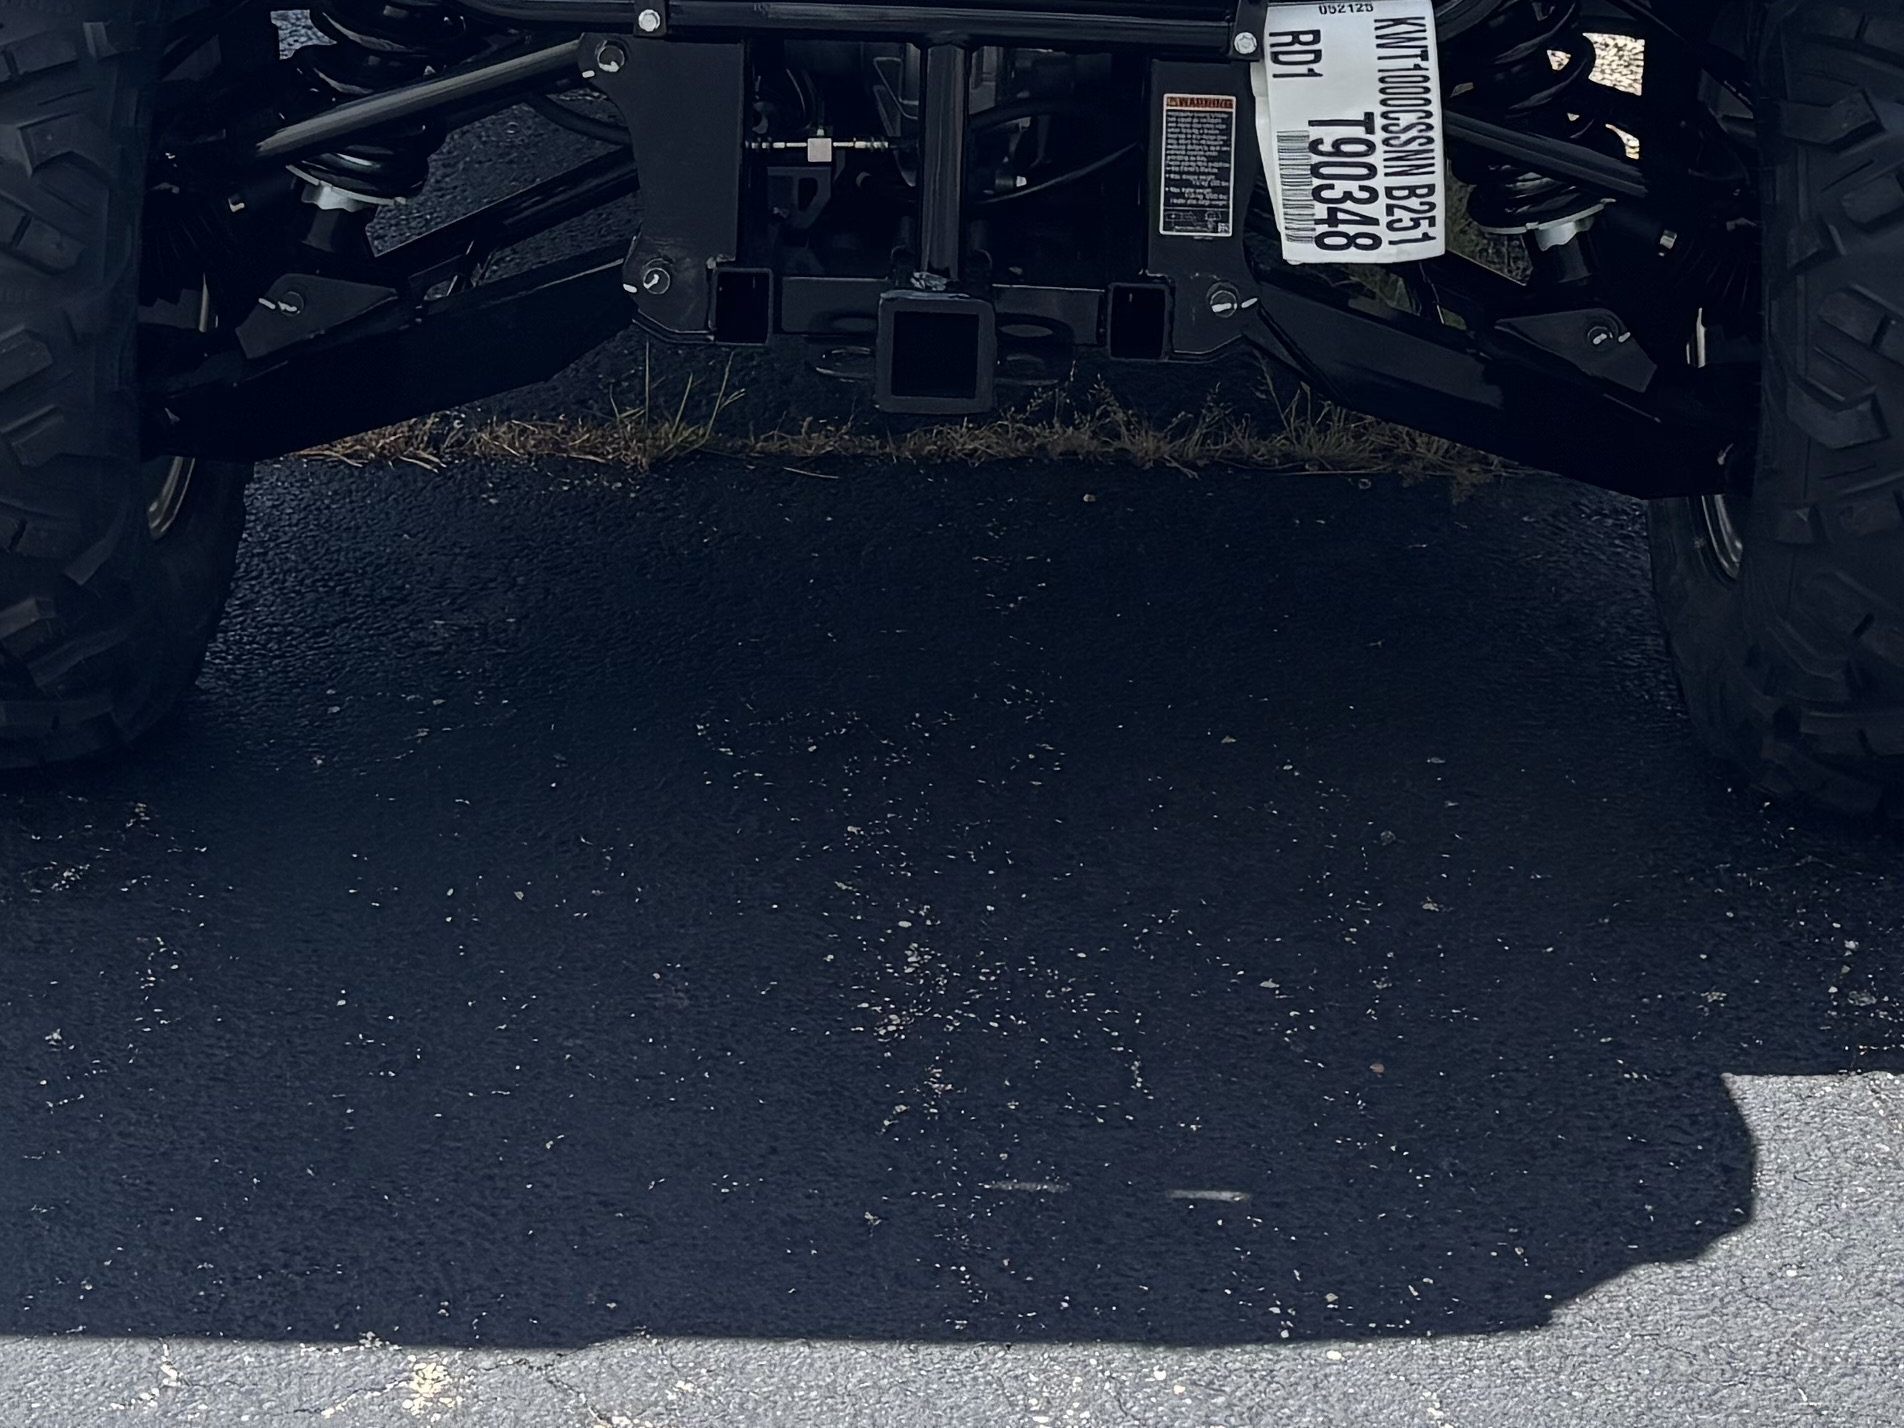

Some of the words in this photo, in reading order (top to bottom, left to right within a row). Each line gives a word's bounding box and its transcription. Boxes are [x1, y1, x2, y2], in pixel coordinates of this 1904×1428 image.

[1269, 29, 1324, 79] RD1
[1374, 16, 1436, 177] KWT1000CSSNN
[1308, 111, 1383, 252] T90348
[1384, 183, 1437, 246] B251
